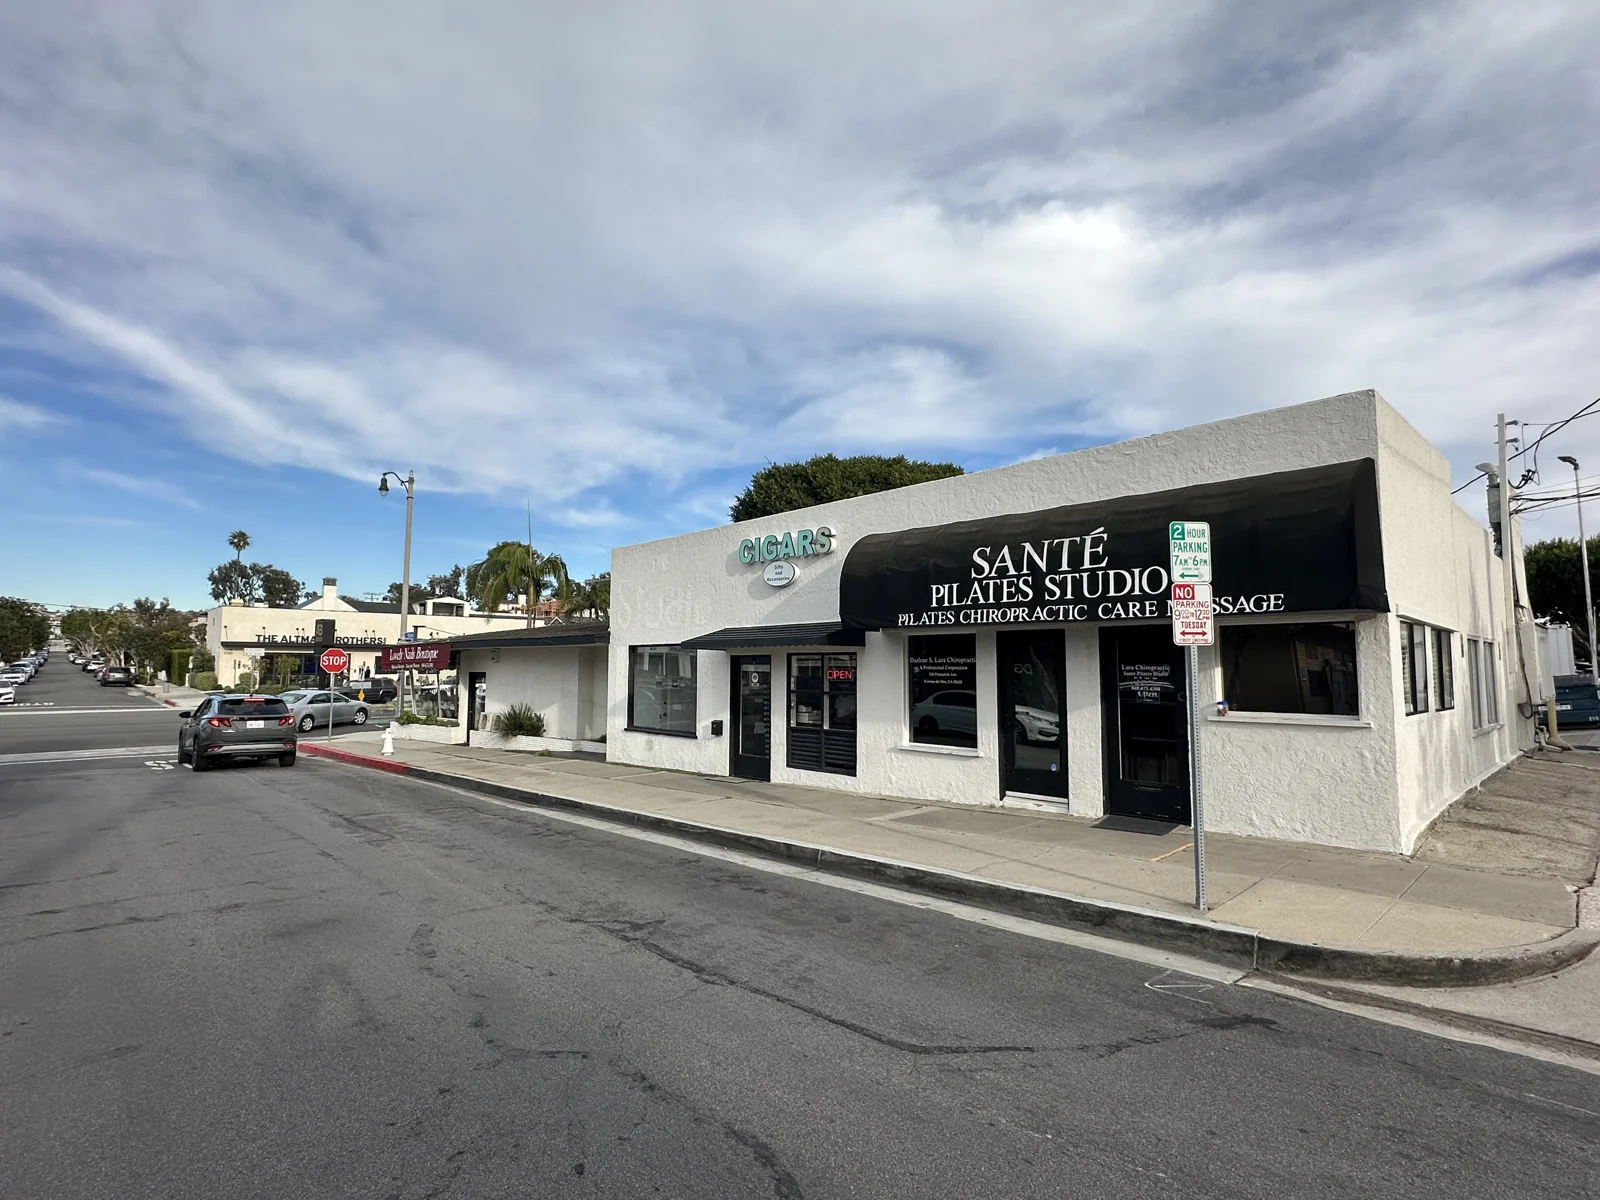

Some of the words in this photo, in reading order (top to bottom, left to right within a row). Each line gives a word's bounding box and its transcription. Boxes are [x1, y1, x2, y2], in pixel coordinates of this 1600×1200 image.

[1173, 525, 1183, 538] 2
[1187, 529, 1206, 538] HOUR
[739, 526, 832, 564] CIGARS
[1173, 542, 1208, 553] PARKING
[971, 526, 1109, 579] SANTÉ
[930, 575, 1034, 608] PILATES
[1044, 565, 1169, 601] STUDIO
[1175, 587, 1193, 599] NO
[898, 611, 955, 626] PILATES
[959, 604, 1087, 624] CHIROPRACTIC
[1098, 600, 1158, 619] CARE
[1181, 621, 1207, 629] TUESDAY
[255, 634, 278, 643] THE
[280, 635, 316, 644] ALTMA
[335, 636, 383, 645] ROTHERS
[416, 645, 439, 662] Boutique
[322, 656, 346, 666] STOP
[946, 656, 976, 664] Chiropracti
[827, 670, 852, 679] OPEN
